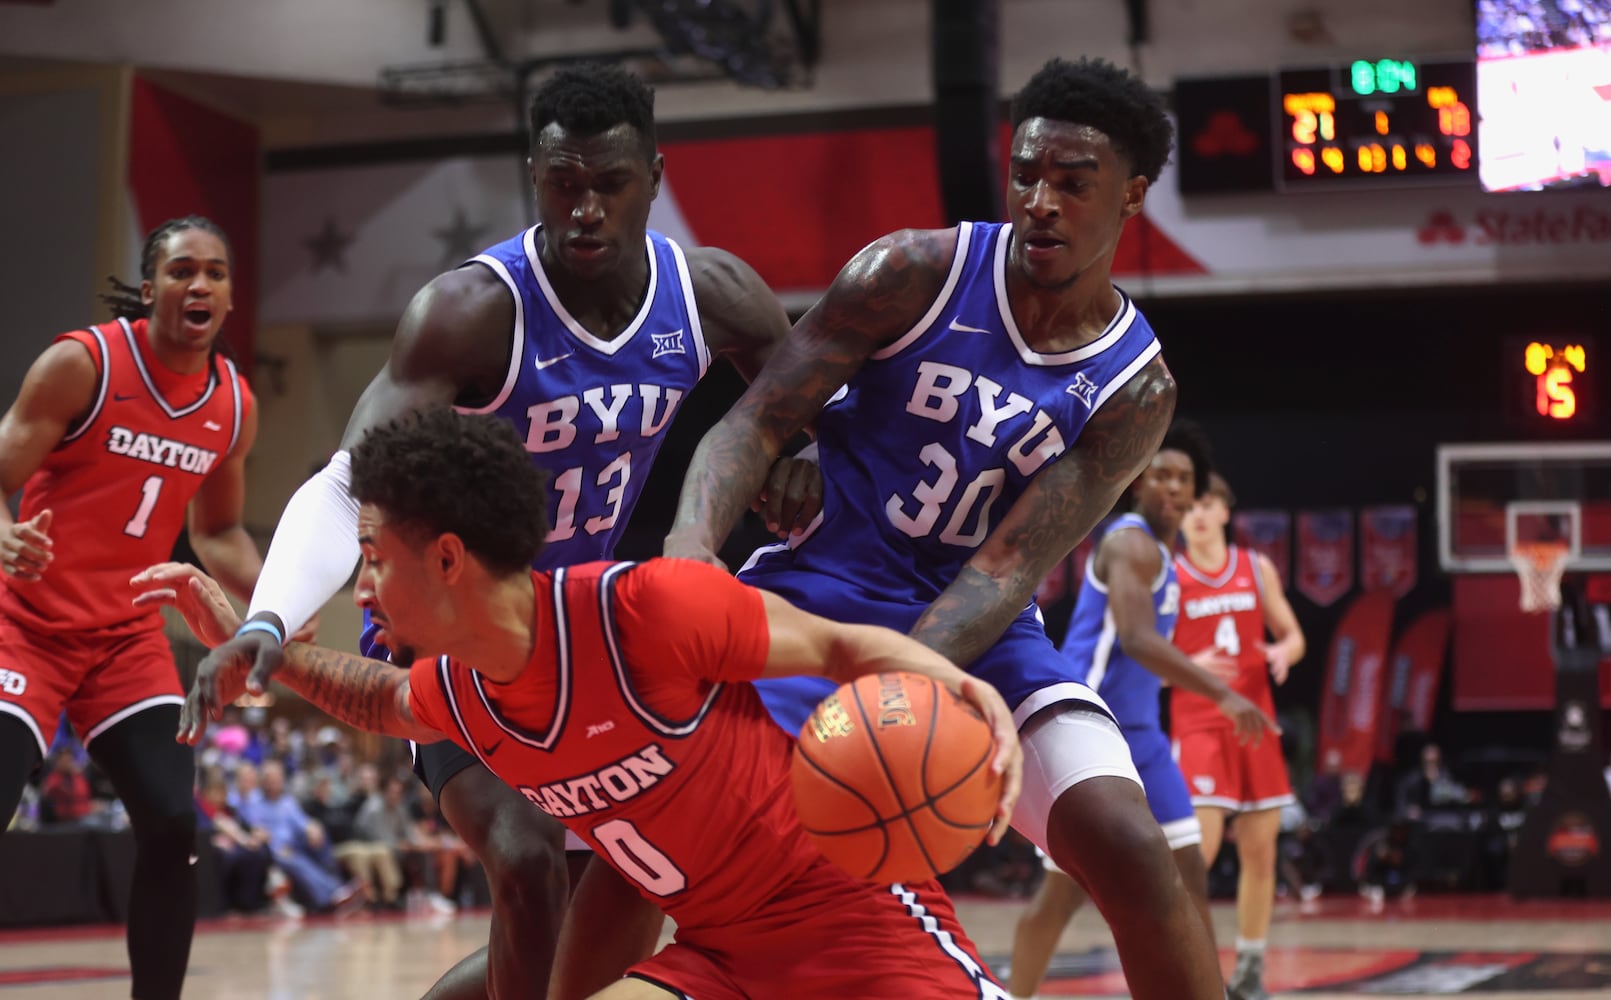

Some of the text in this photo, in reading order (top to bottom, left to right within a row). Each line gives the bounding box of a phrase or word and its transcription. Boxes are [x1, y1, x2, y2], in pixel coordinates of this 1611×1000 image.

[106, 425, 219, 476] DAYTON
[524, 383, 683, 453] BYU
[905, 361, 1066, 477] BYU
[122, 475, 164, 539] 1
[544, 450, 632, 543] 13
[885, 442, 1006, 548] 30
[1213, 615, 1240, 657] 4
[591, 818, 687, 897] 0
